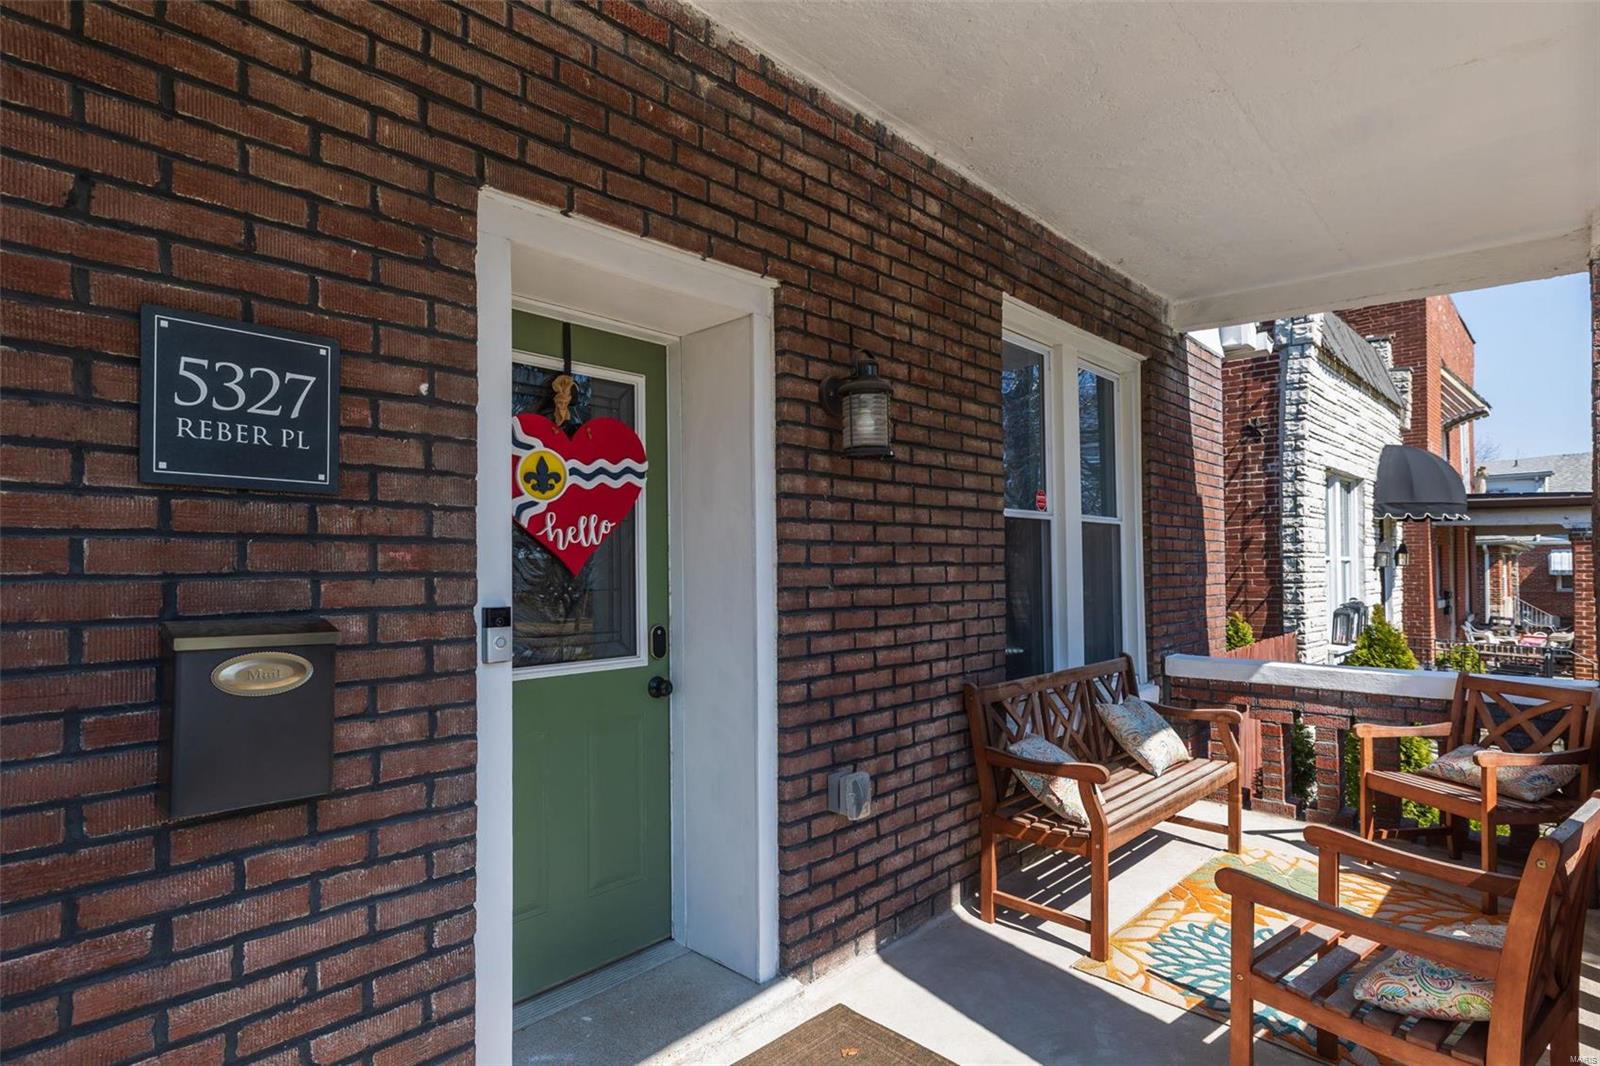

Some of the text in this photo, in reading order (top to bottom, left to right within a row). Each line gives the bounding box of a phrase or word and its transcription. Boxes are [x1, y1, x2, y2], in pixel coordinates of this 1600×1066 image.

[174, 356, 316, 419] 5327
[176, 417, 310, 450] REBER PL
[536, 511, 616, 550] hello
[247, 665, 281, 680] Mail
